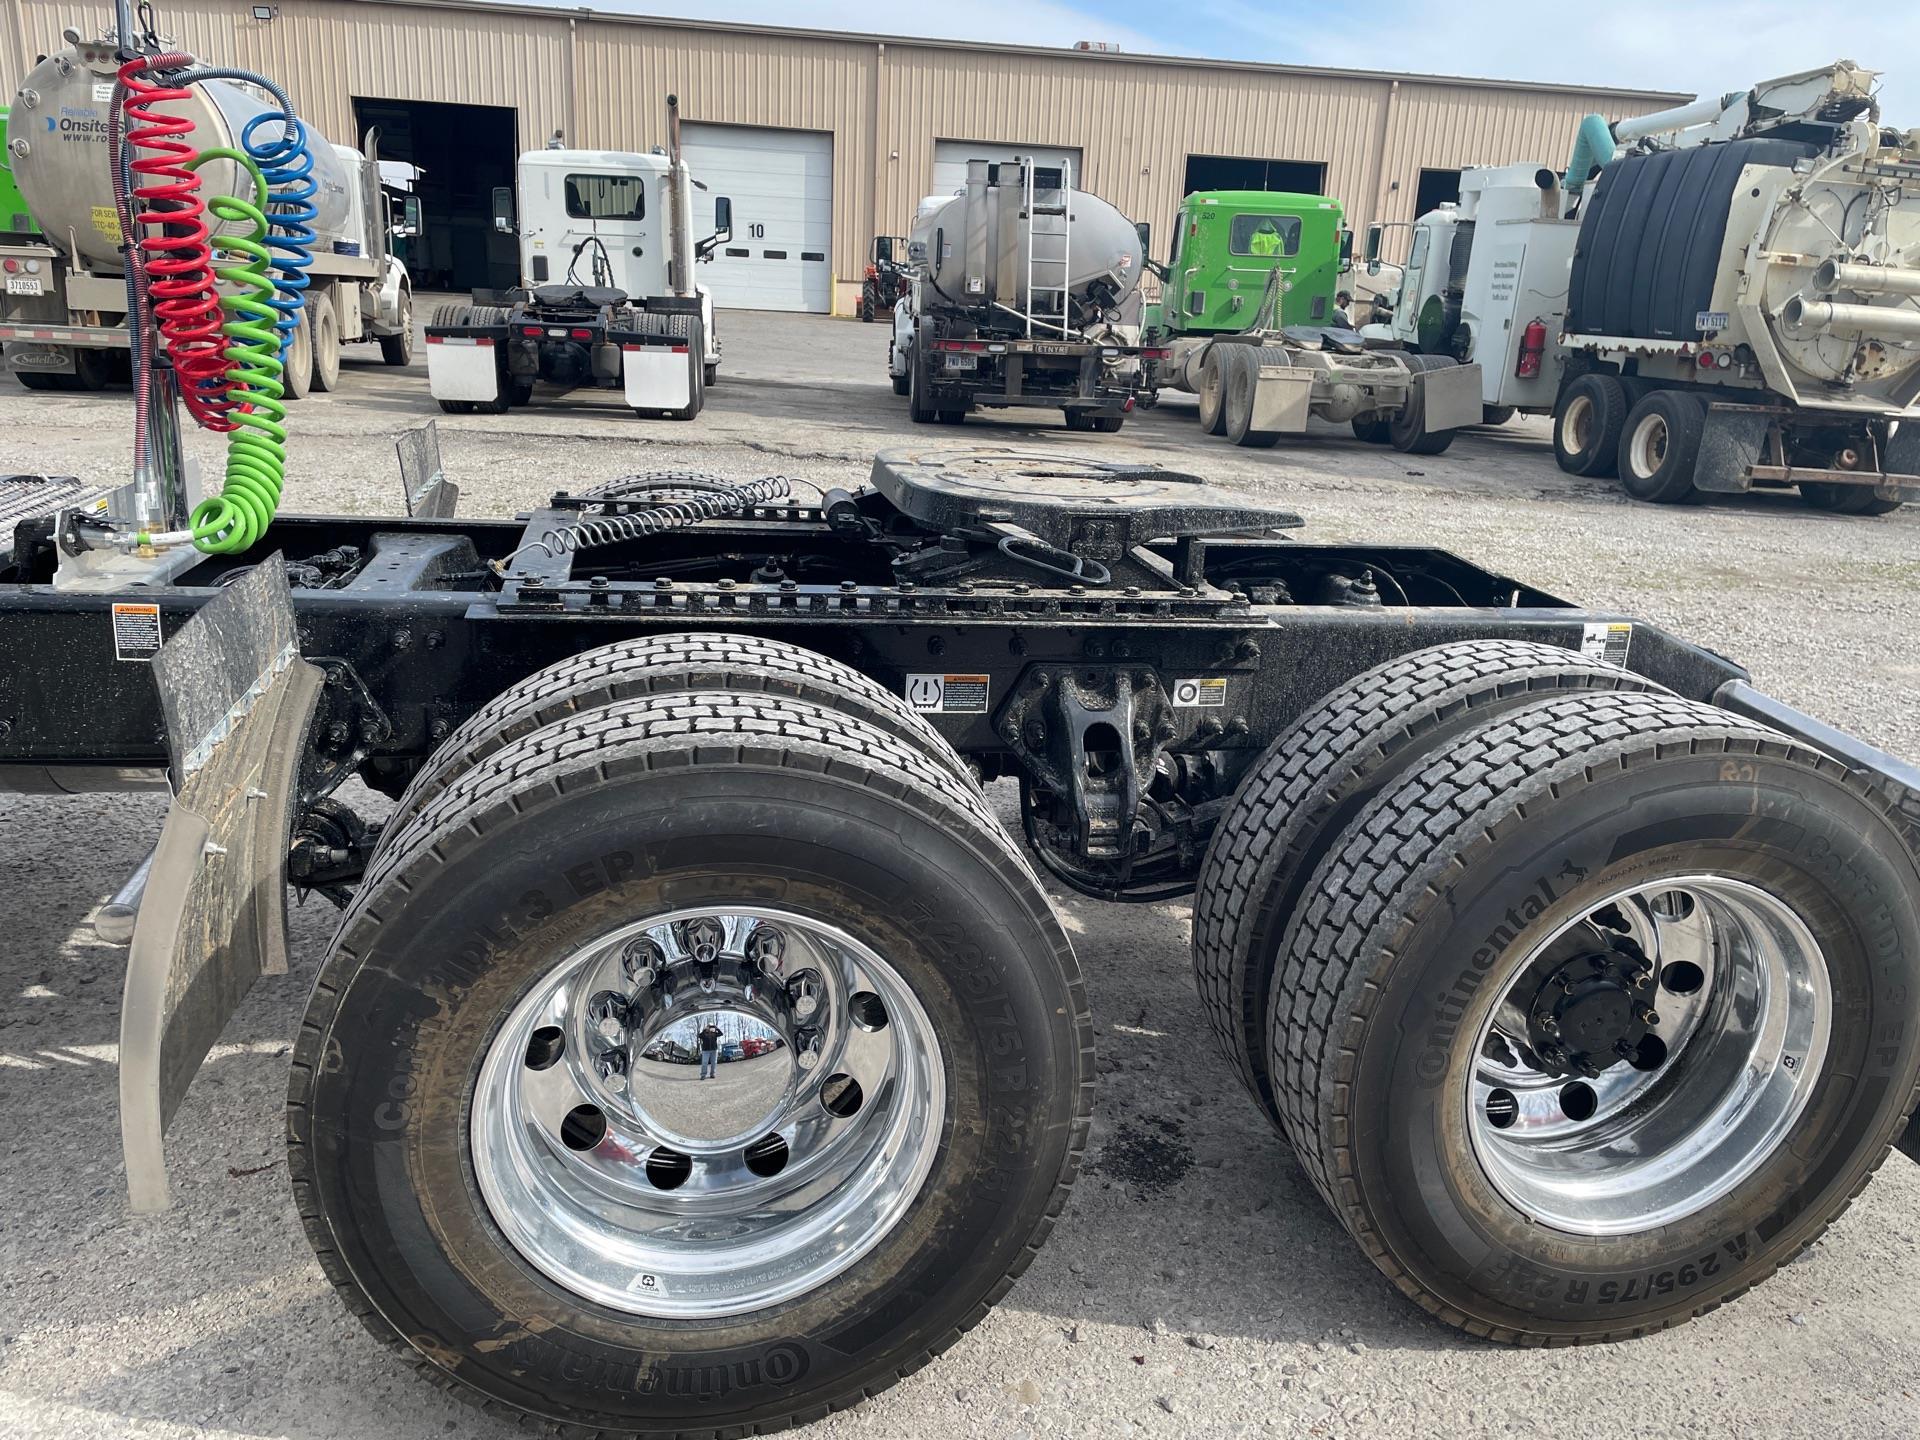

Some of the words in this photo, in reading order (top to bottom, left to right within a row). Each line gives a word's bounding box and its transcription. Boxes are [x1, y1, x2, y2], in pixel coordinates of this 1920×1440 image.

[60, 106, 98, 118] Reliable
[60, 117, 109, 133] Onsite
[748, 223, 764, 238] 10
[21, 354, 60, 365] Satellite
[1414, 878, 1560, 1090] Continental
[1596, 1251, 1722, 1305] 295/75
[635, 1284, 660, 1292] ALCOA
[1562, 1278, 1590, 1304] R
[539, 1341, 811, 1402] Continental
